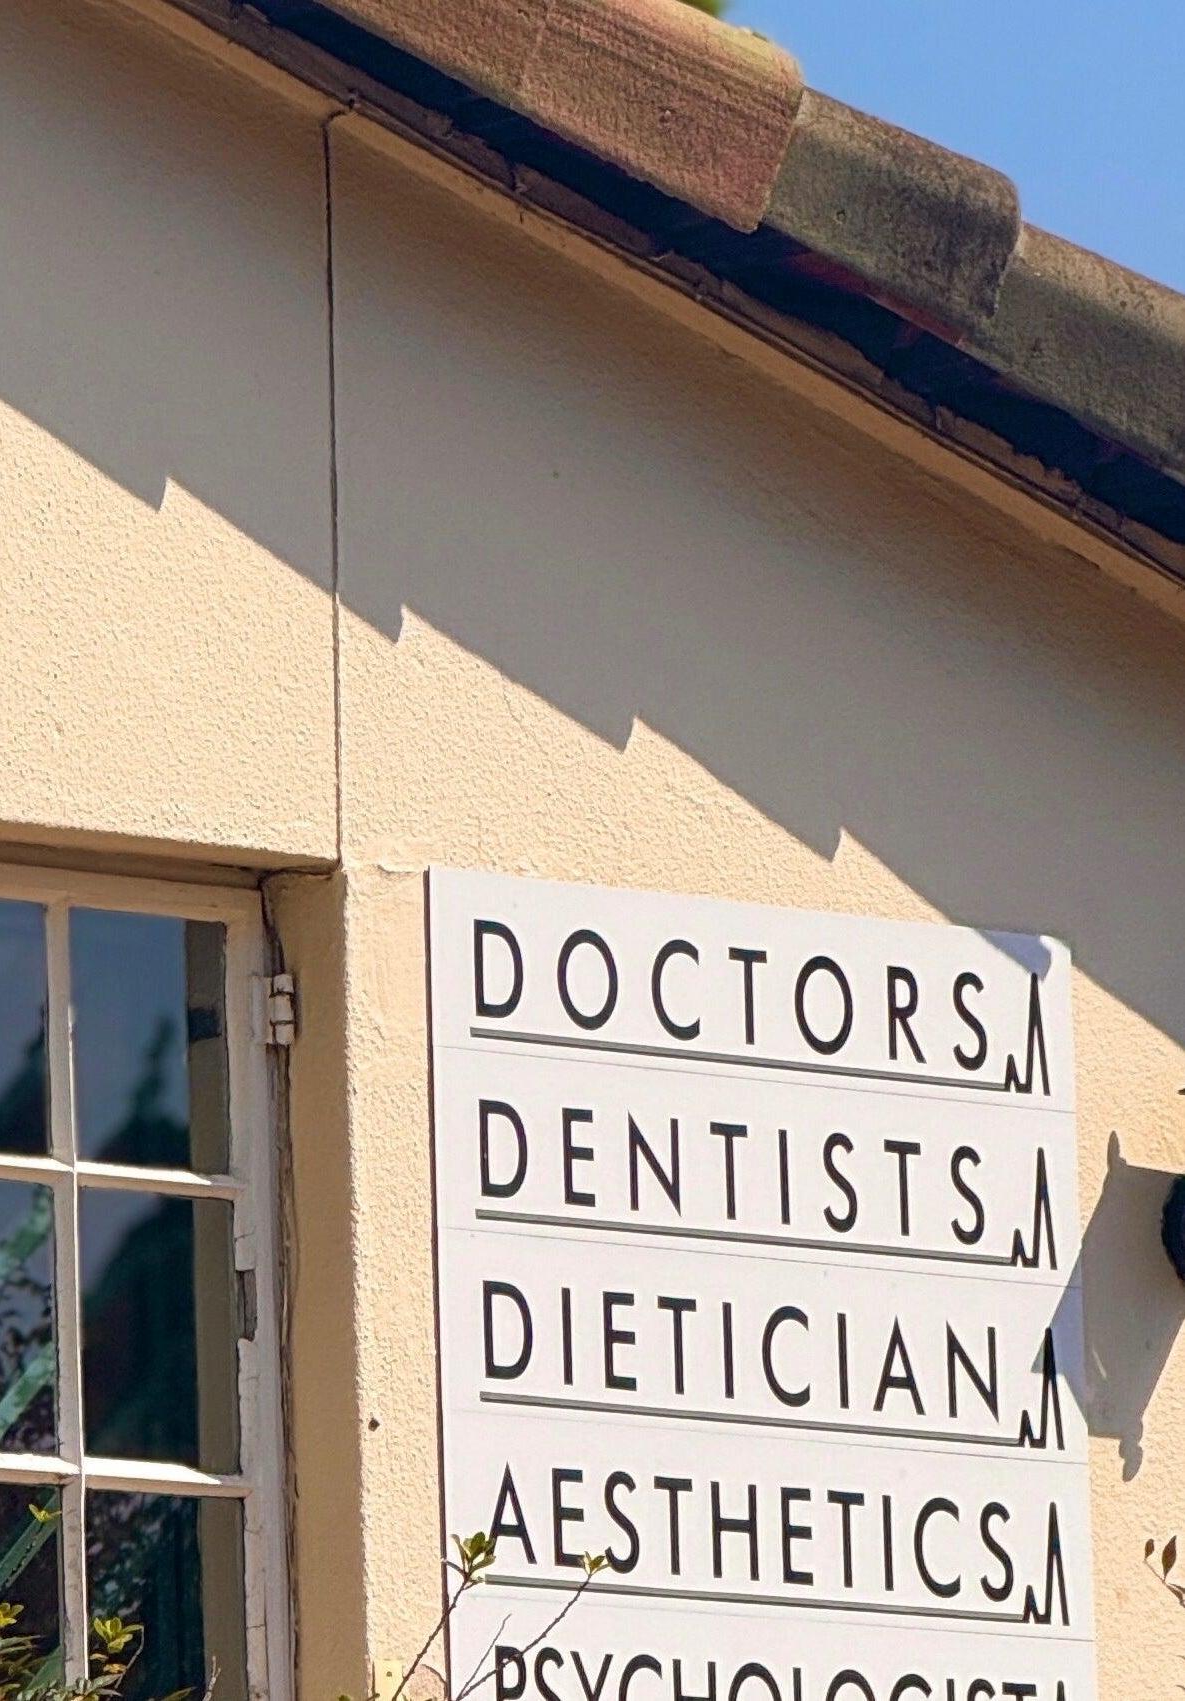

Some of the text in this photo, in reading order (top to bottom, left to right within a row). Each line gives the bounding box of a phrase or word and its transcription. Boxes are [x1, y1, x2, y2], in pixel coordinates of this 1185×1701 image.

[473, 919, 988, 1071] DOCTORS
[478, 1099, 985, 1245] DENTISTS
[482, 1280, 999, 1421] DIETICIAN
[489, 1463, 1014, 1602] AESTHETICS
